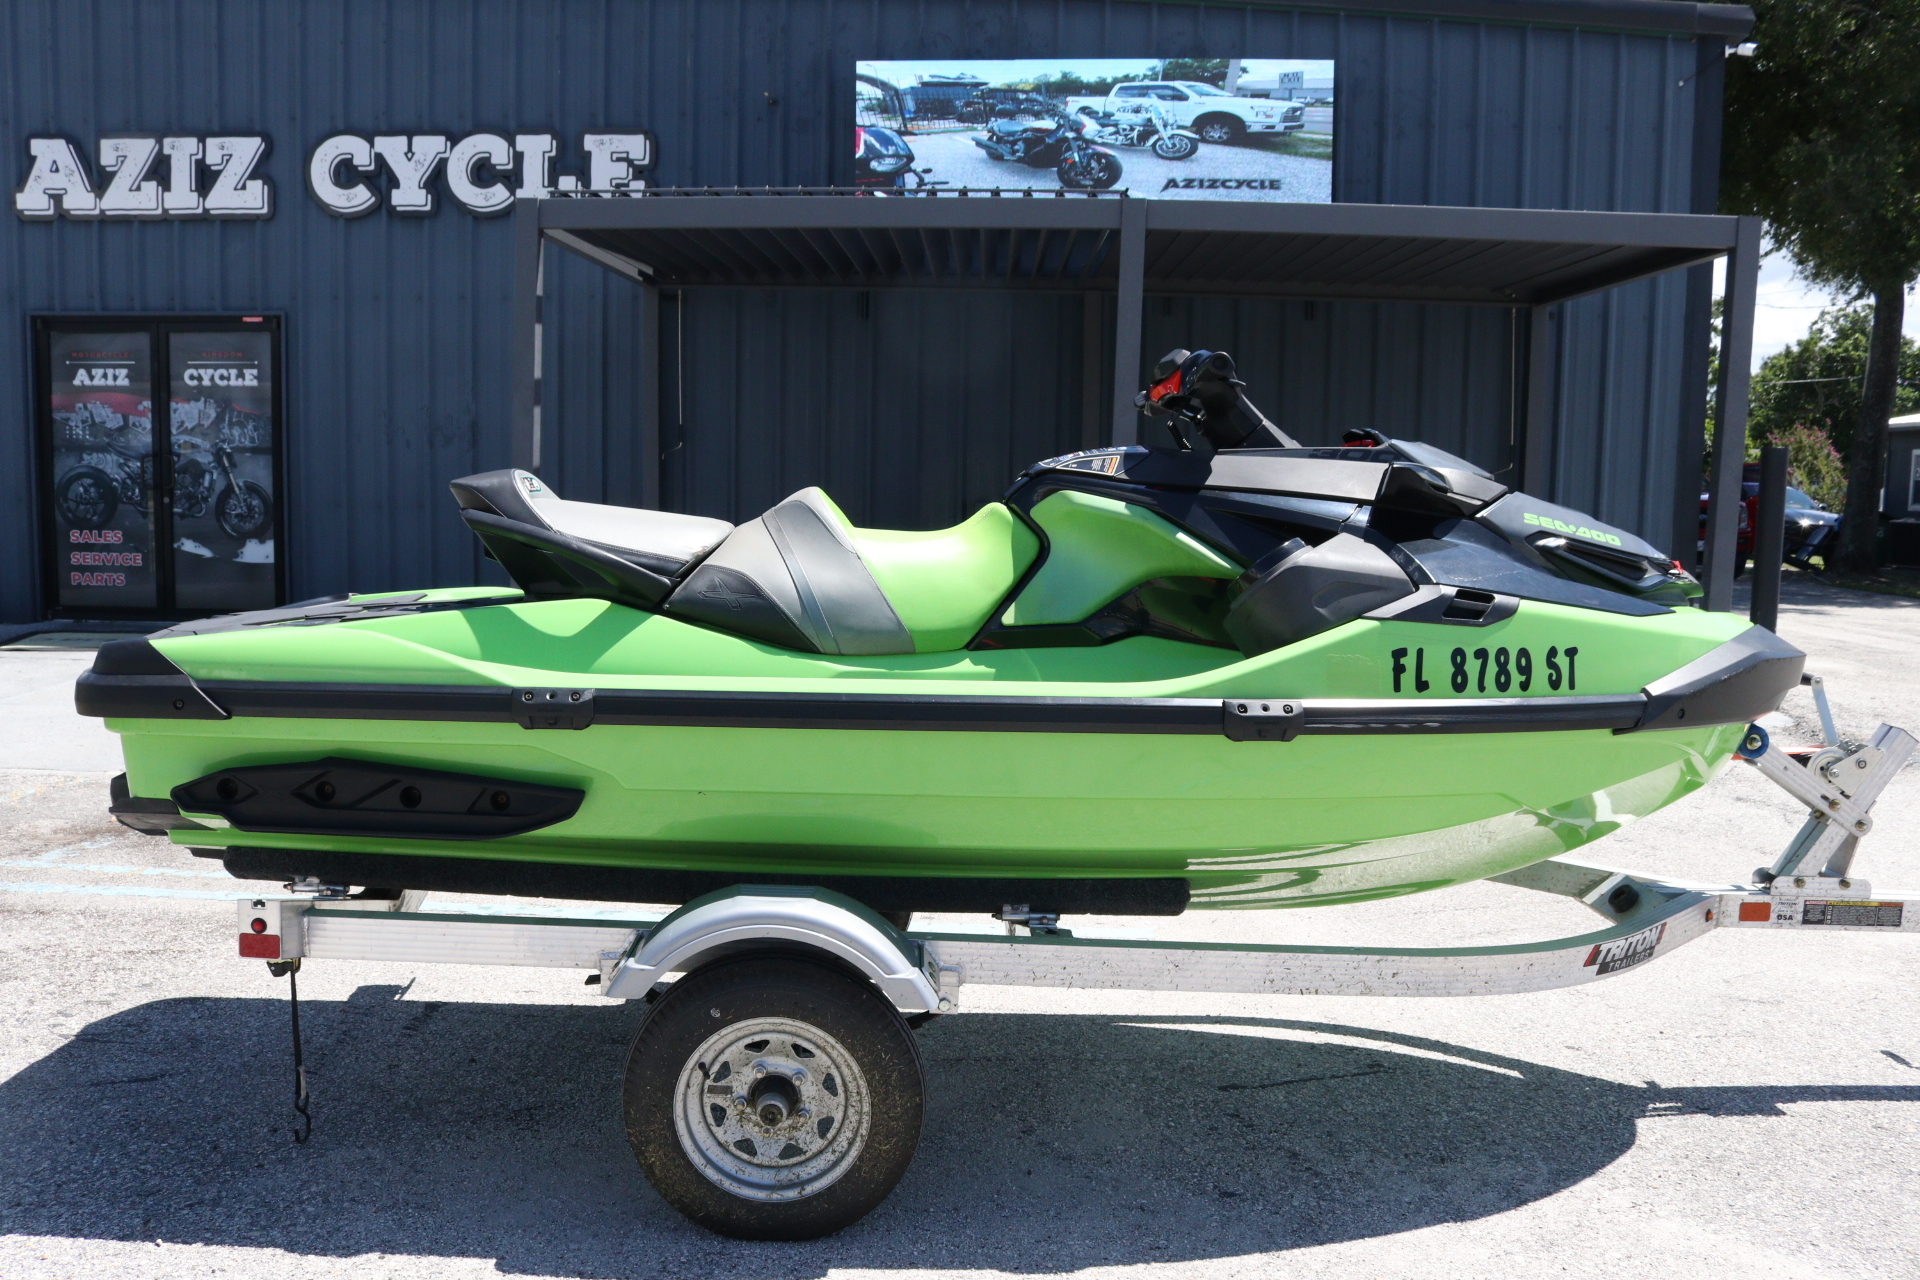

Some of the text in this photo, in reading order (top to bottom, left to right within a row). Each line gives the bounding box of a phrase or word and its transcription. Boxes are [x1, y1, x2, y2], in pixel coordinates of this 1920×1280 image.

[15, 133, 650, 216] AZIZ CYCLE
[1159, 178, 1281, 193] AZIZCYCLE
[73, 368, 130, 386] AZIZ
[183, 368, 258, 386] CYCLE
[70, 529, 123, 544] SALES
[70, 552, 143, 567] SERVICE
[71, 572, 126, 587] PARTS
[1391, 646, 1578, 693] FL 8789 ST
[1596, 925, 1662, 964] TRITON
[1609, 950, 1650, 971] TRAILERS
